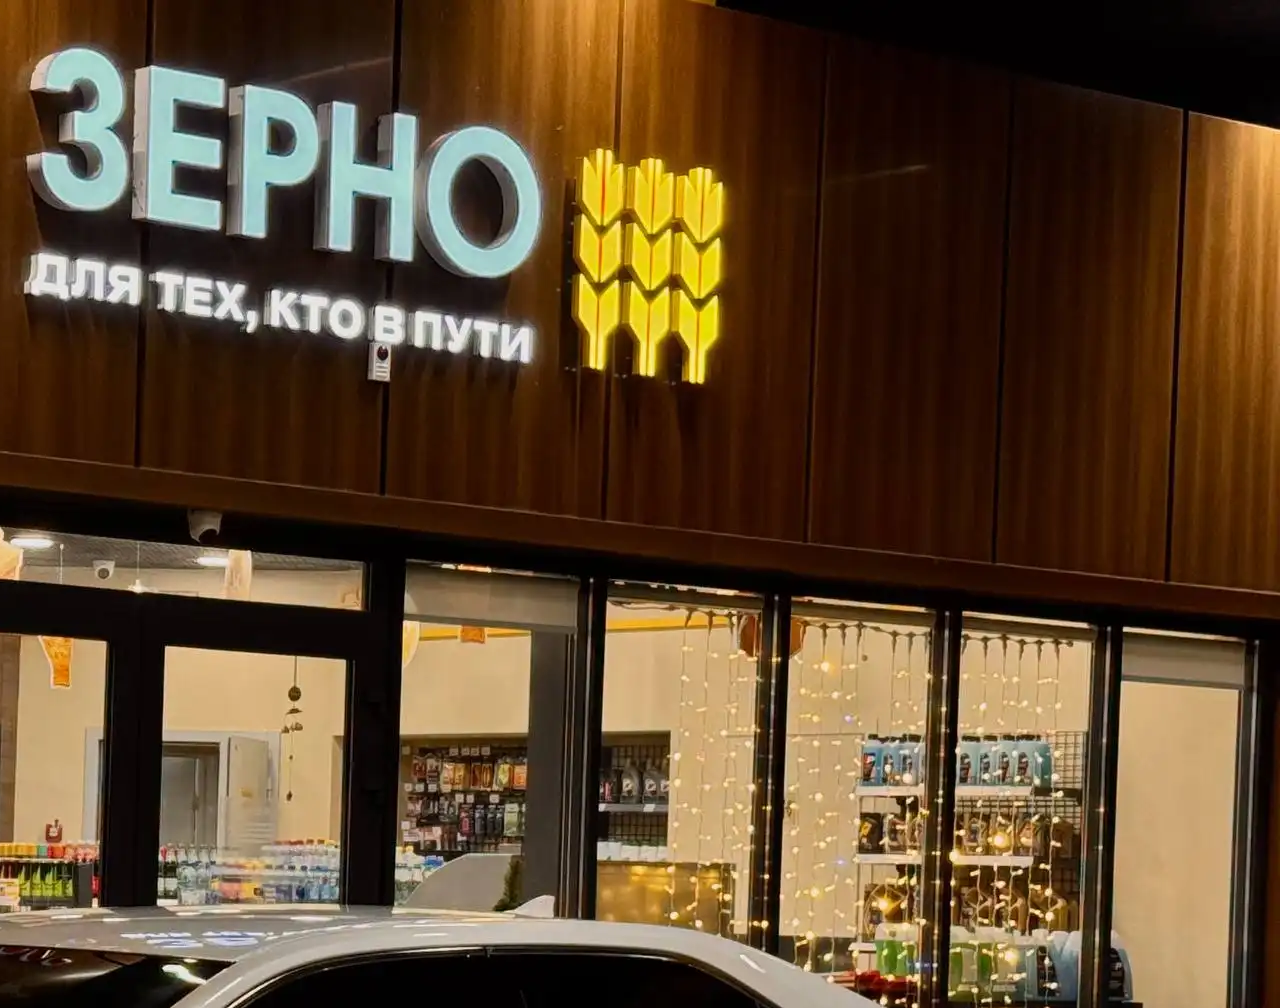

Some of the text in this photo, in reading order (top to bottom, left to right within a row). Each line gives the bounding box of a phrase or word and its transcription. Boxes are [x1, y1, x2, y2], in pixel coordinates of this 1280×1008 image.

[26, 47, 542, 278] ЗЕРНО
[23, 253, 533, 363] ДЛЯ ТЕХ, КТО В ПУТИ
